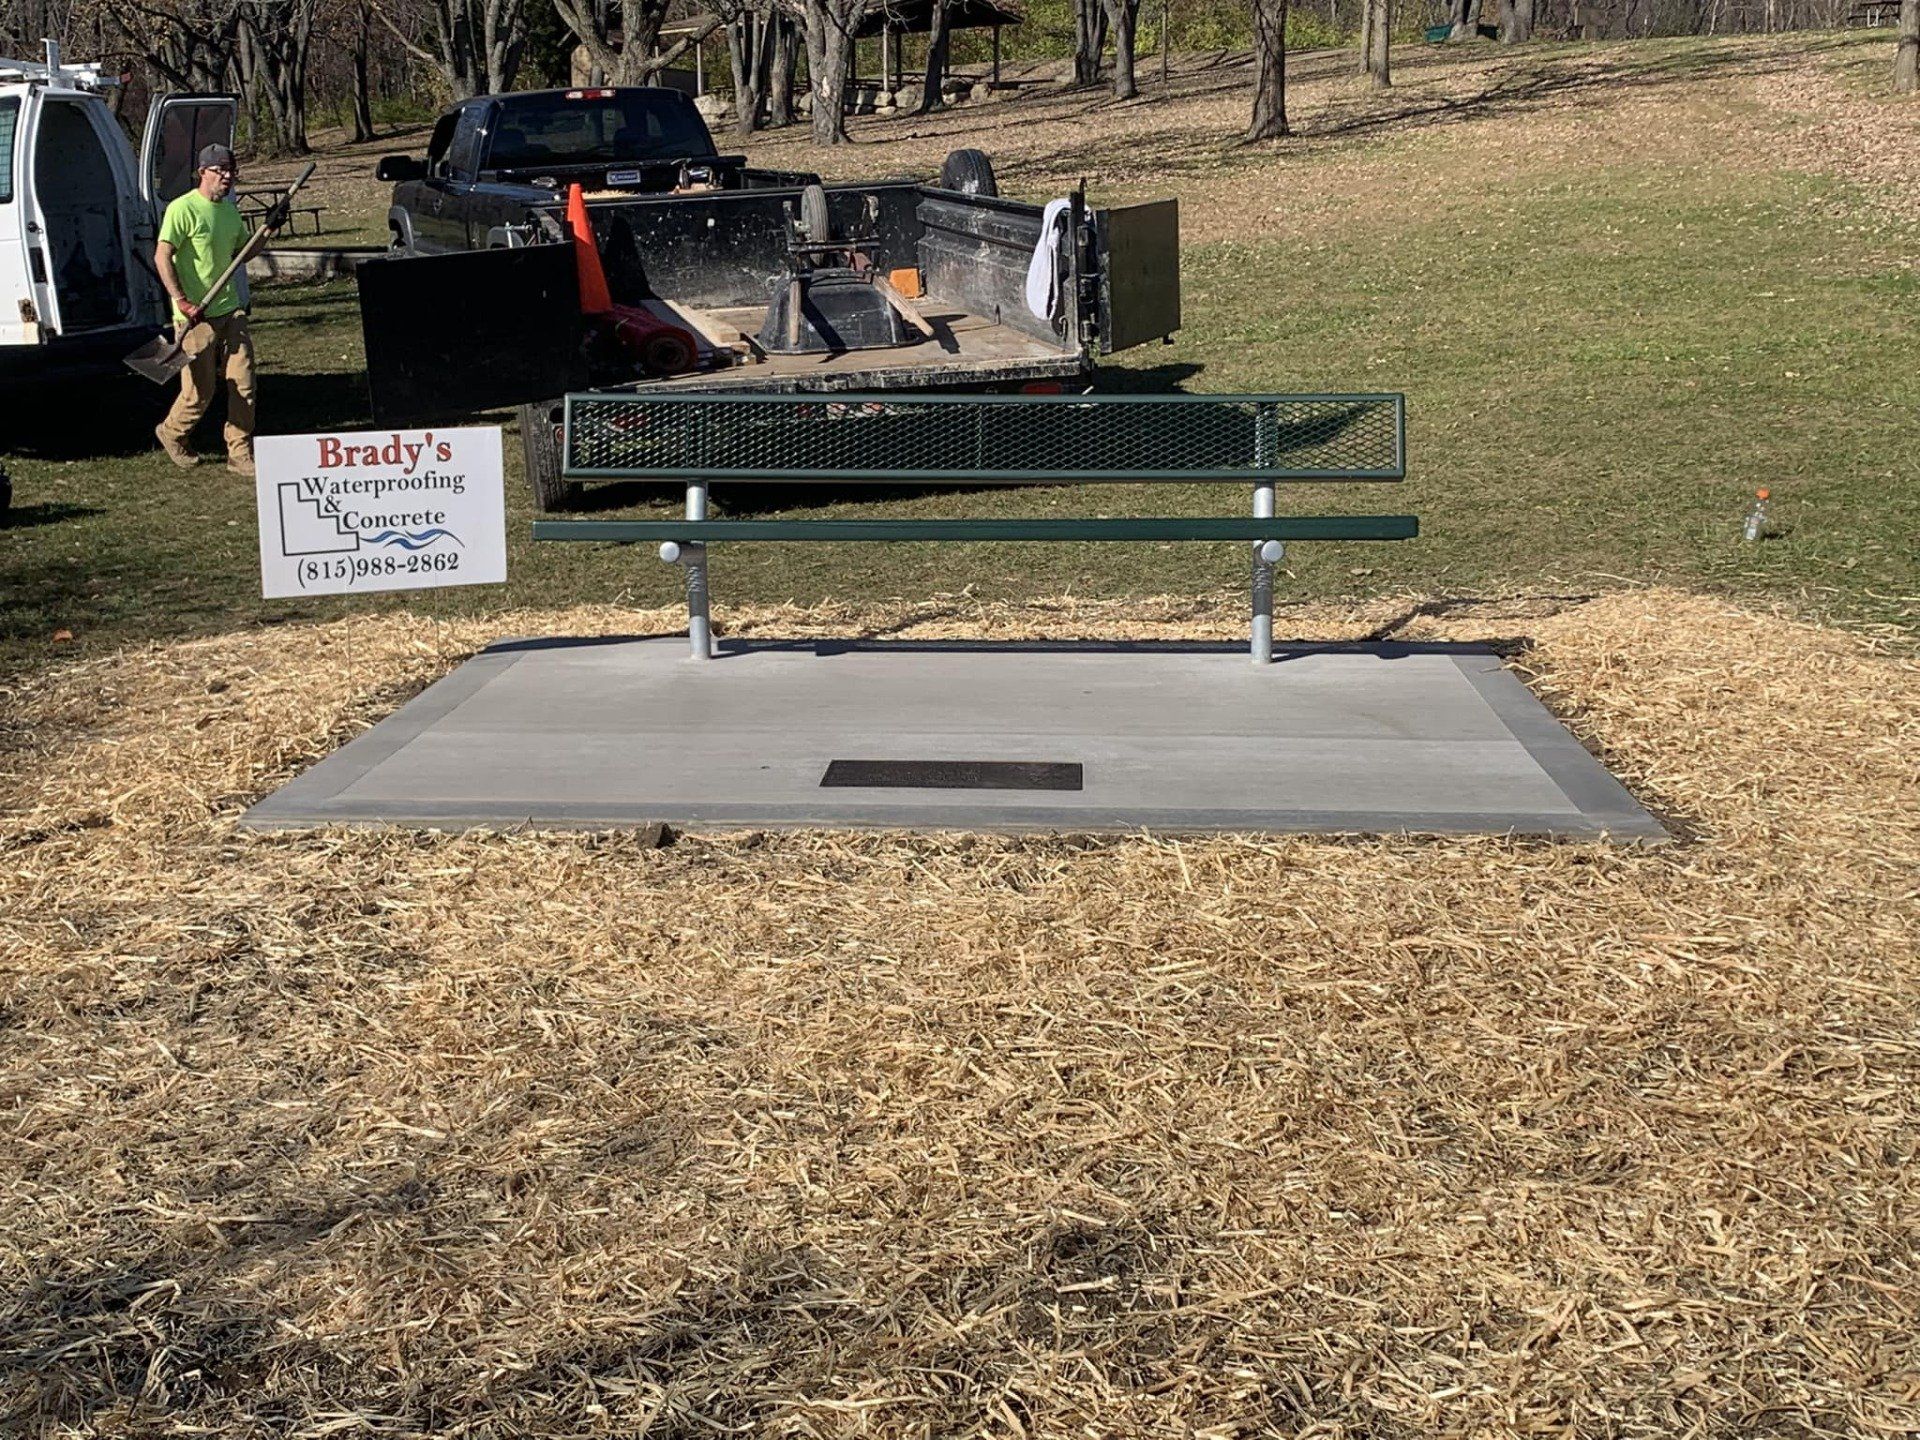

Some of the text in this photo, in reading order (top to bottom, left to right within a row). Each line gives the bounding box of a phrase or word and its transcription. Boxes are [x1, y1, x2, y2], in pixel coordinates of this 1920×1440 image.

[317, 432, 452, 474] Brady's
[302, 470, 465, 499] Waterproofing
[324, 495, 342, 514] &
[343, 509, 446, 529] Concrete
[298, 552, 459, 589] (815)988-2862
